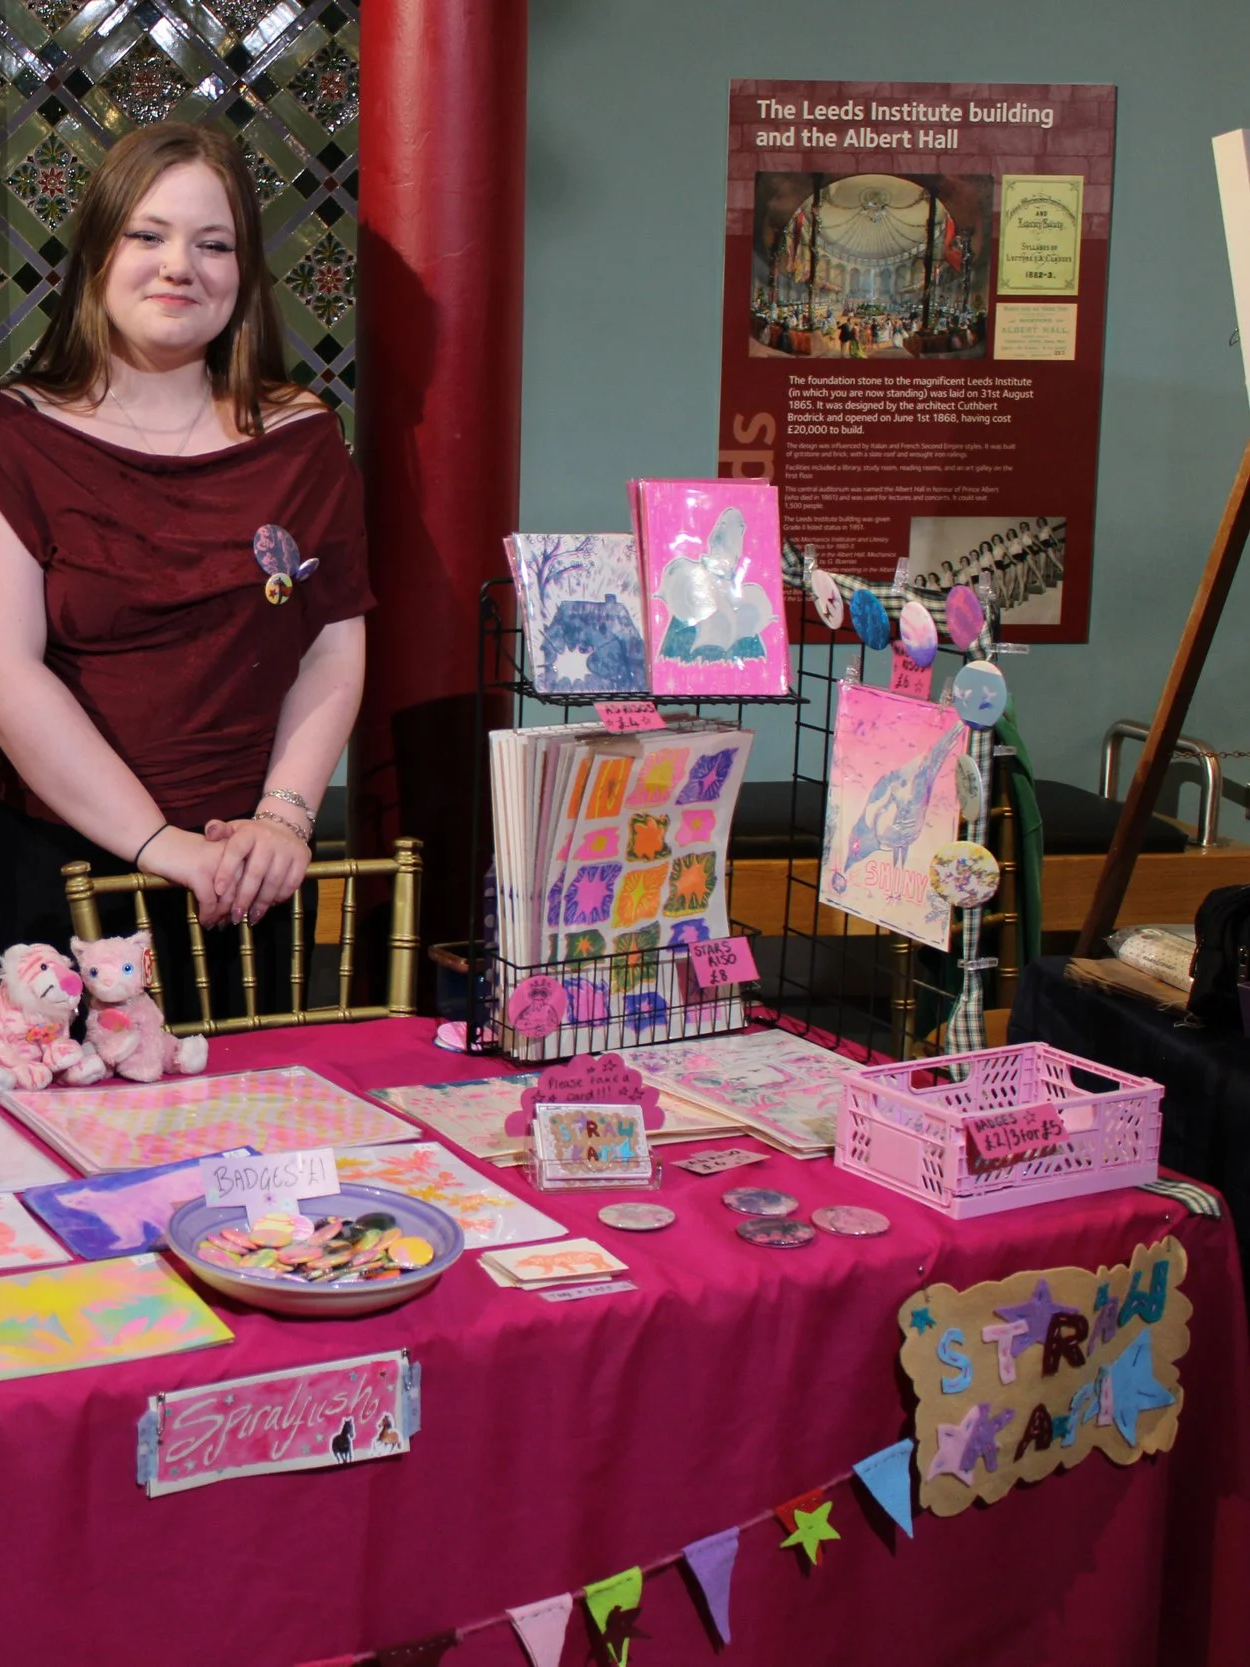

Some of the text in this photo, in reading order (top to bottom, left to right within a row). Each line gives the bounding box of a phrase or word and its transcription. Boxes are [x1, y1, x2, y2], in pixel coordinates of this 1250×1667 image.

[756, 99, 1054, 129] The Leeds Institute building
[756, 127, 959, 149] and the Albert Hall
[789, 375, 1032, 388] The foundation stone to the magnificent Leeds Institute
[788, 388, 800, 398] (in
[802, 388, 829, 397] which
[830, 390, 847, 400] you
[886, 388, 928, 400] standing)
[930, 390, 947, 398] was
[949, 389, 965, 398] laid
[966, 390, 978, 398] on
[981, 389, 1000, 398] 31st
[1002, 390, 1034, 401] August
[789, 400, 998, 412] 1865. It was designed by the architect Cuthbert
[787, 412, 1011, 425] Brodrick and opened on June 1st 1868, having cost
[787, 425, 865, 435] £20,000 to build.
[865, 860, 929, 907] SHINY
[693, 941, 732, 957] STARS
[710, 969, 728, 985] £8
[548, 1075, 582, 1090] Please
[623, 1074, 630, 1083] a
[558, 1119, 634, 1143] STRAW
[213, 1164, 299, 1199] BADGES
